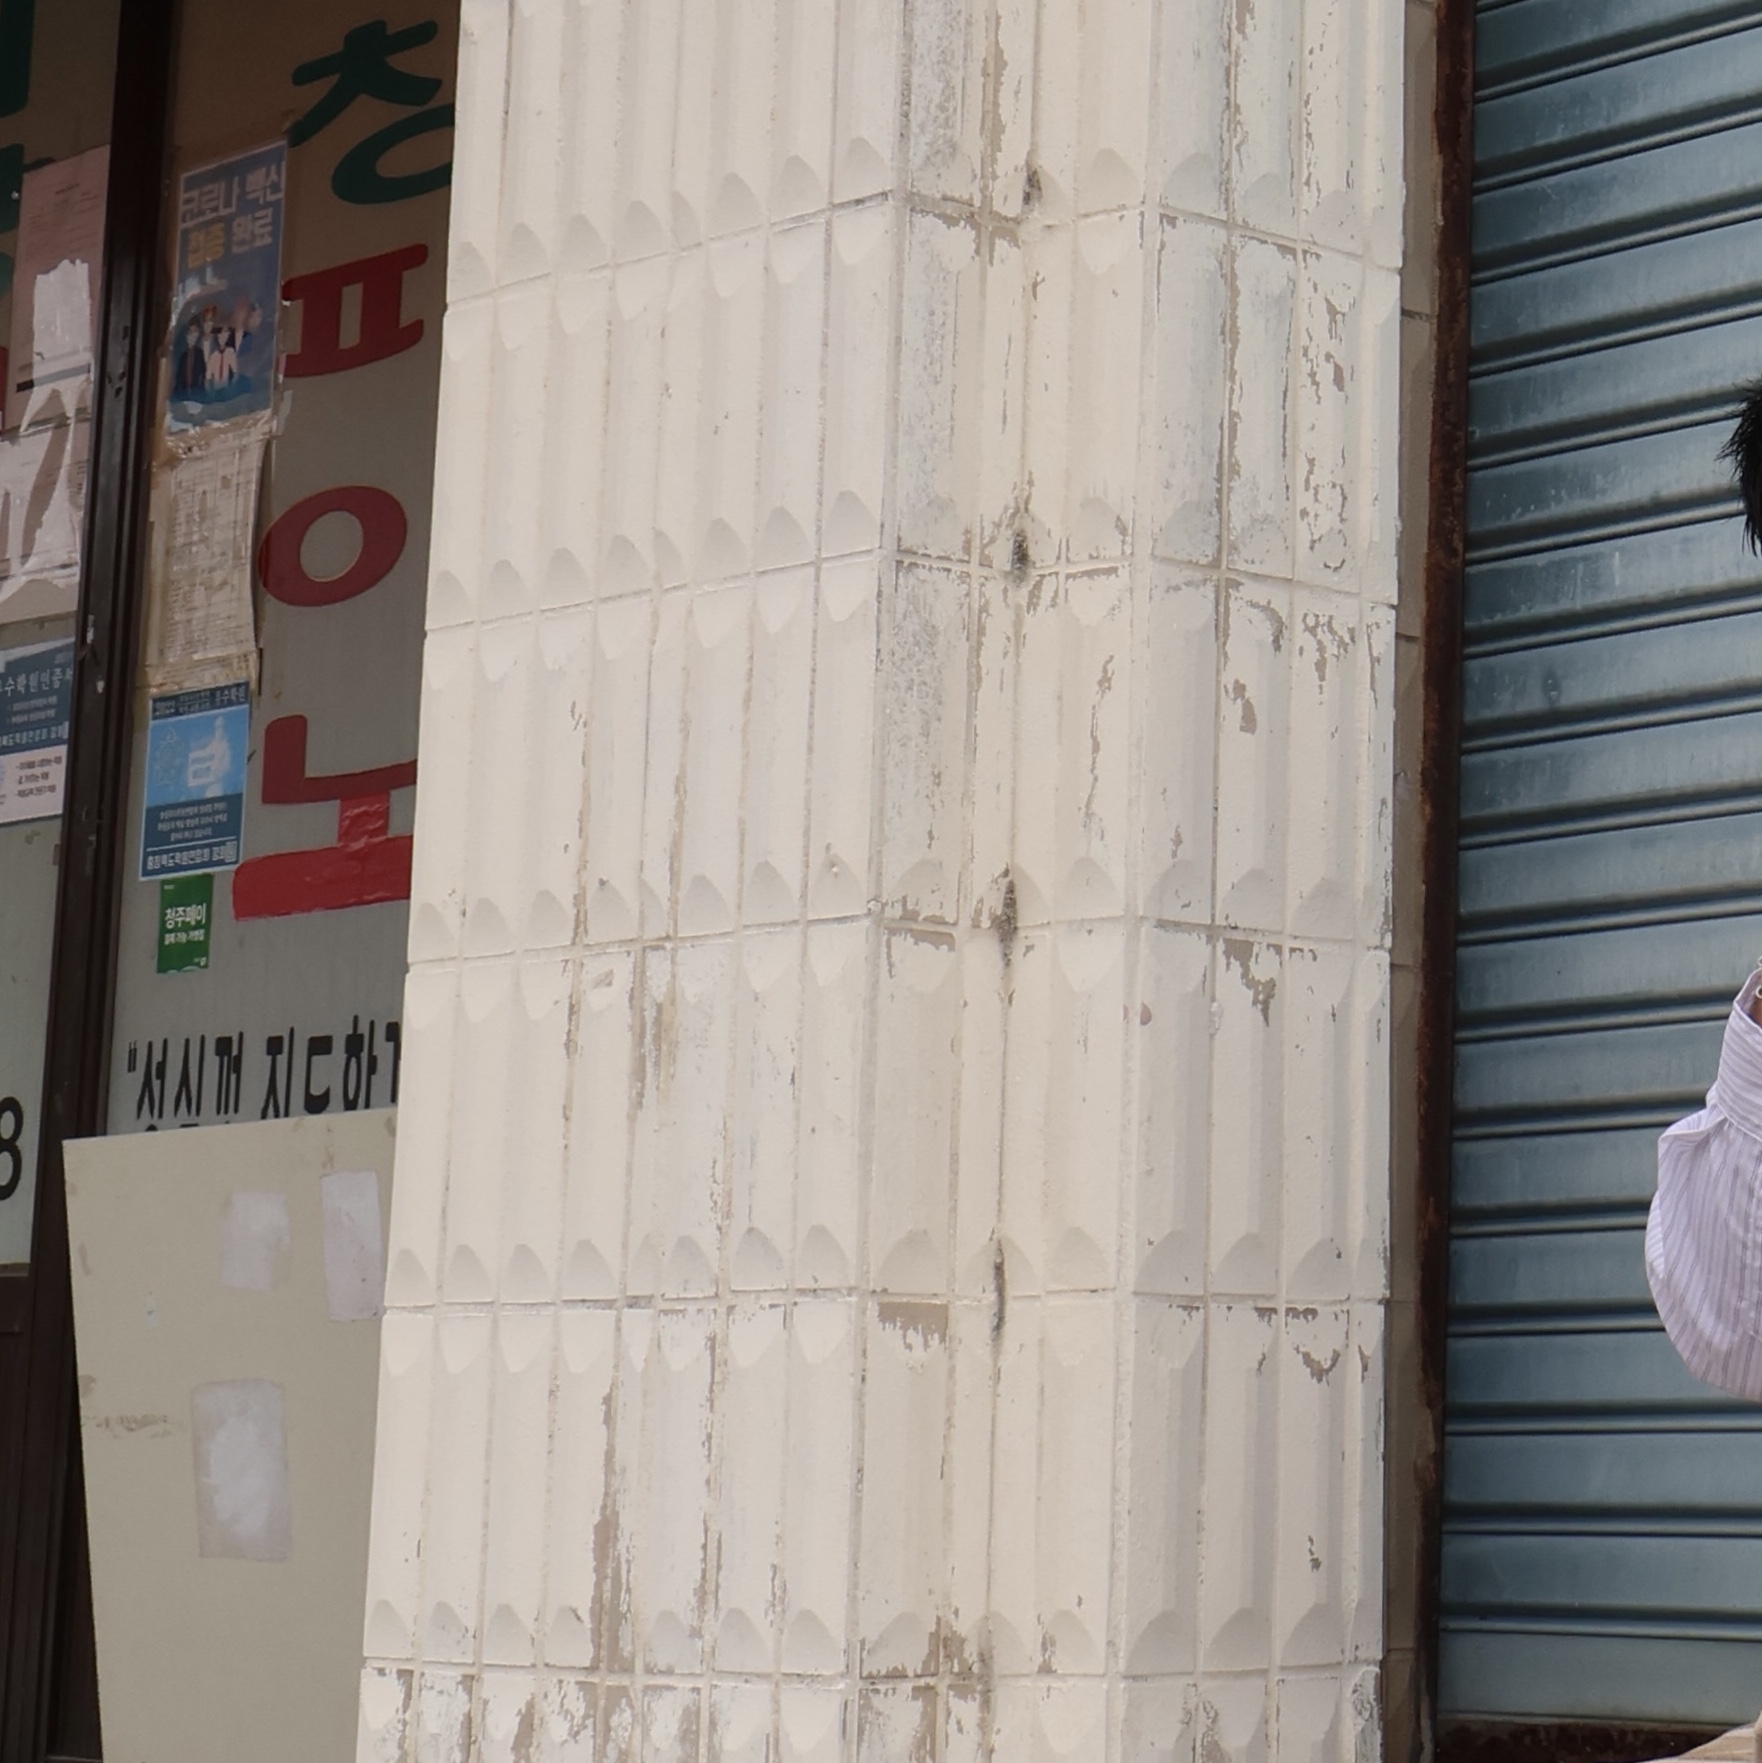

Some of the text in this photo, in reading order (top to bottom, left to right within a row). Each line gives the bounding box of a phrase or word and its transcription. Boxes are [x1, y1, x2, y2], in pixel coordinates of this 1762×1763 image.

[180, 161, 286, 230] 코로나 백신
[188, 207, 274, 270] 접종 완료
[165, 902, 207, 930] 청주페이
